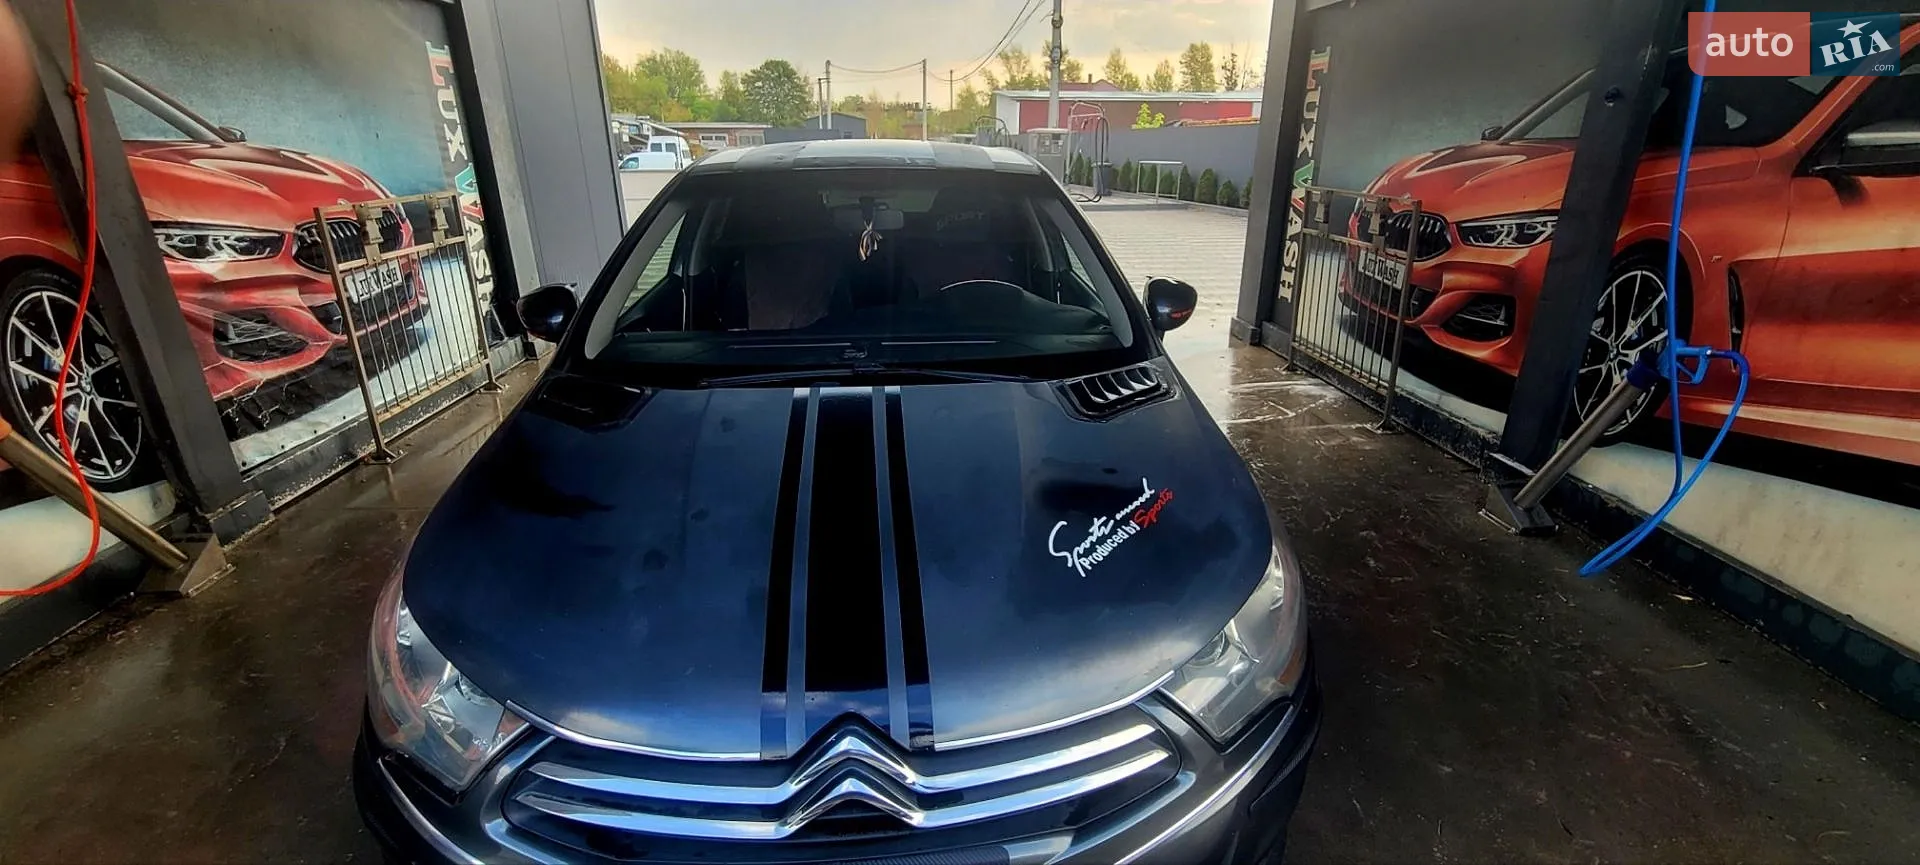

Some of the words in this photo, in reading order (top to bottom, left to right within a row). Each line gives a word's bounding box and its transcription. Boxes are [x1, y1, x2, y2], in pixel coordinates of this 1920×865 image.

[1297, 46, 1331, 158] LUX
[1078, 527, 1129, 570] Produced
[1121, 519, 1140, 535] by
[1134, 488, 1173, 528] Sports
